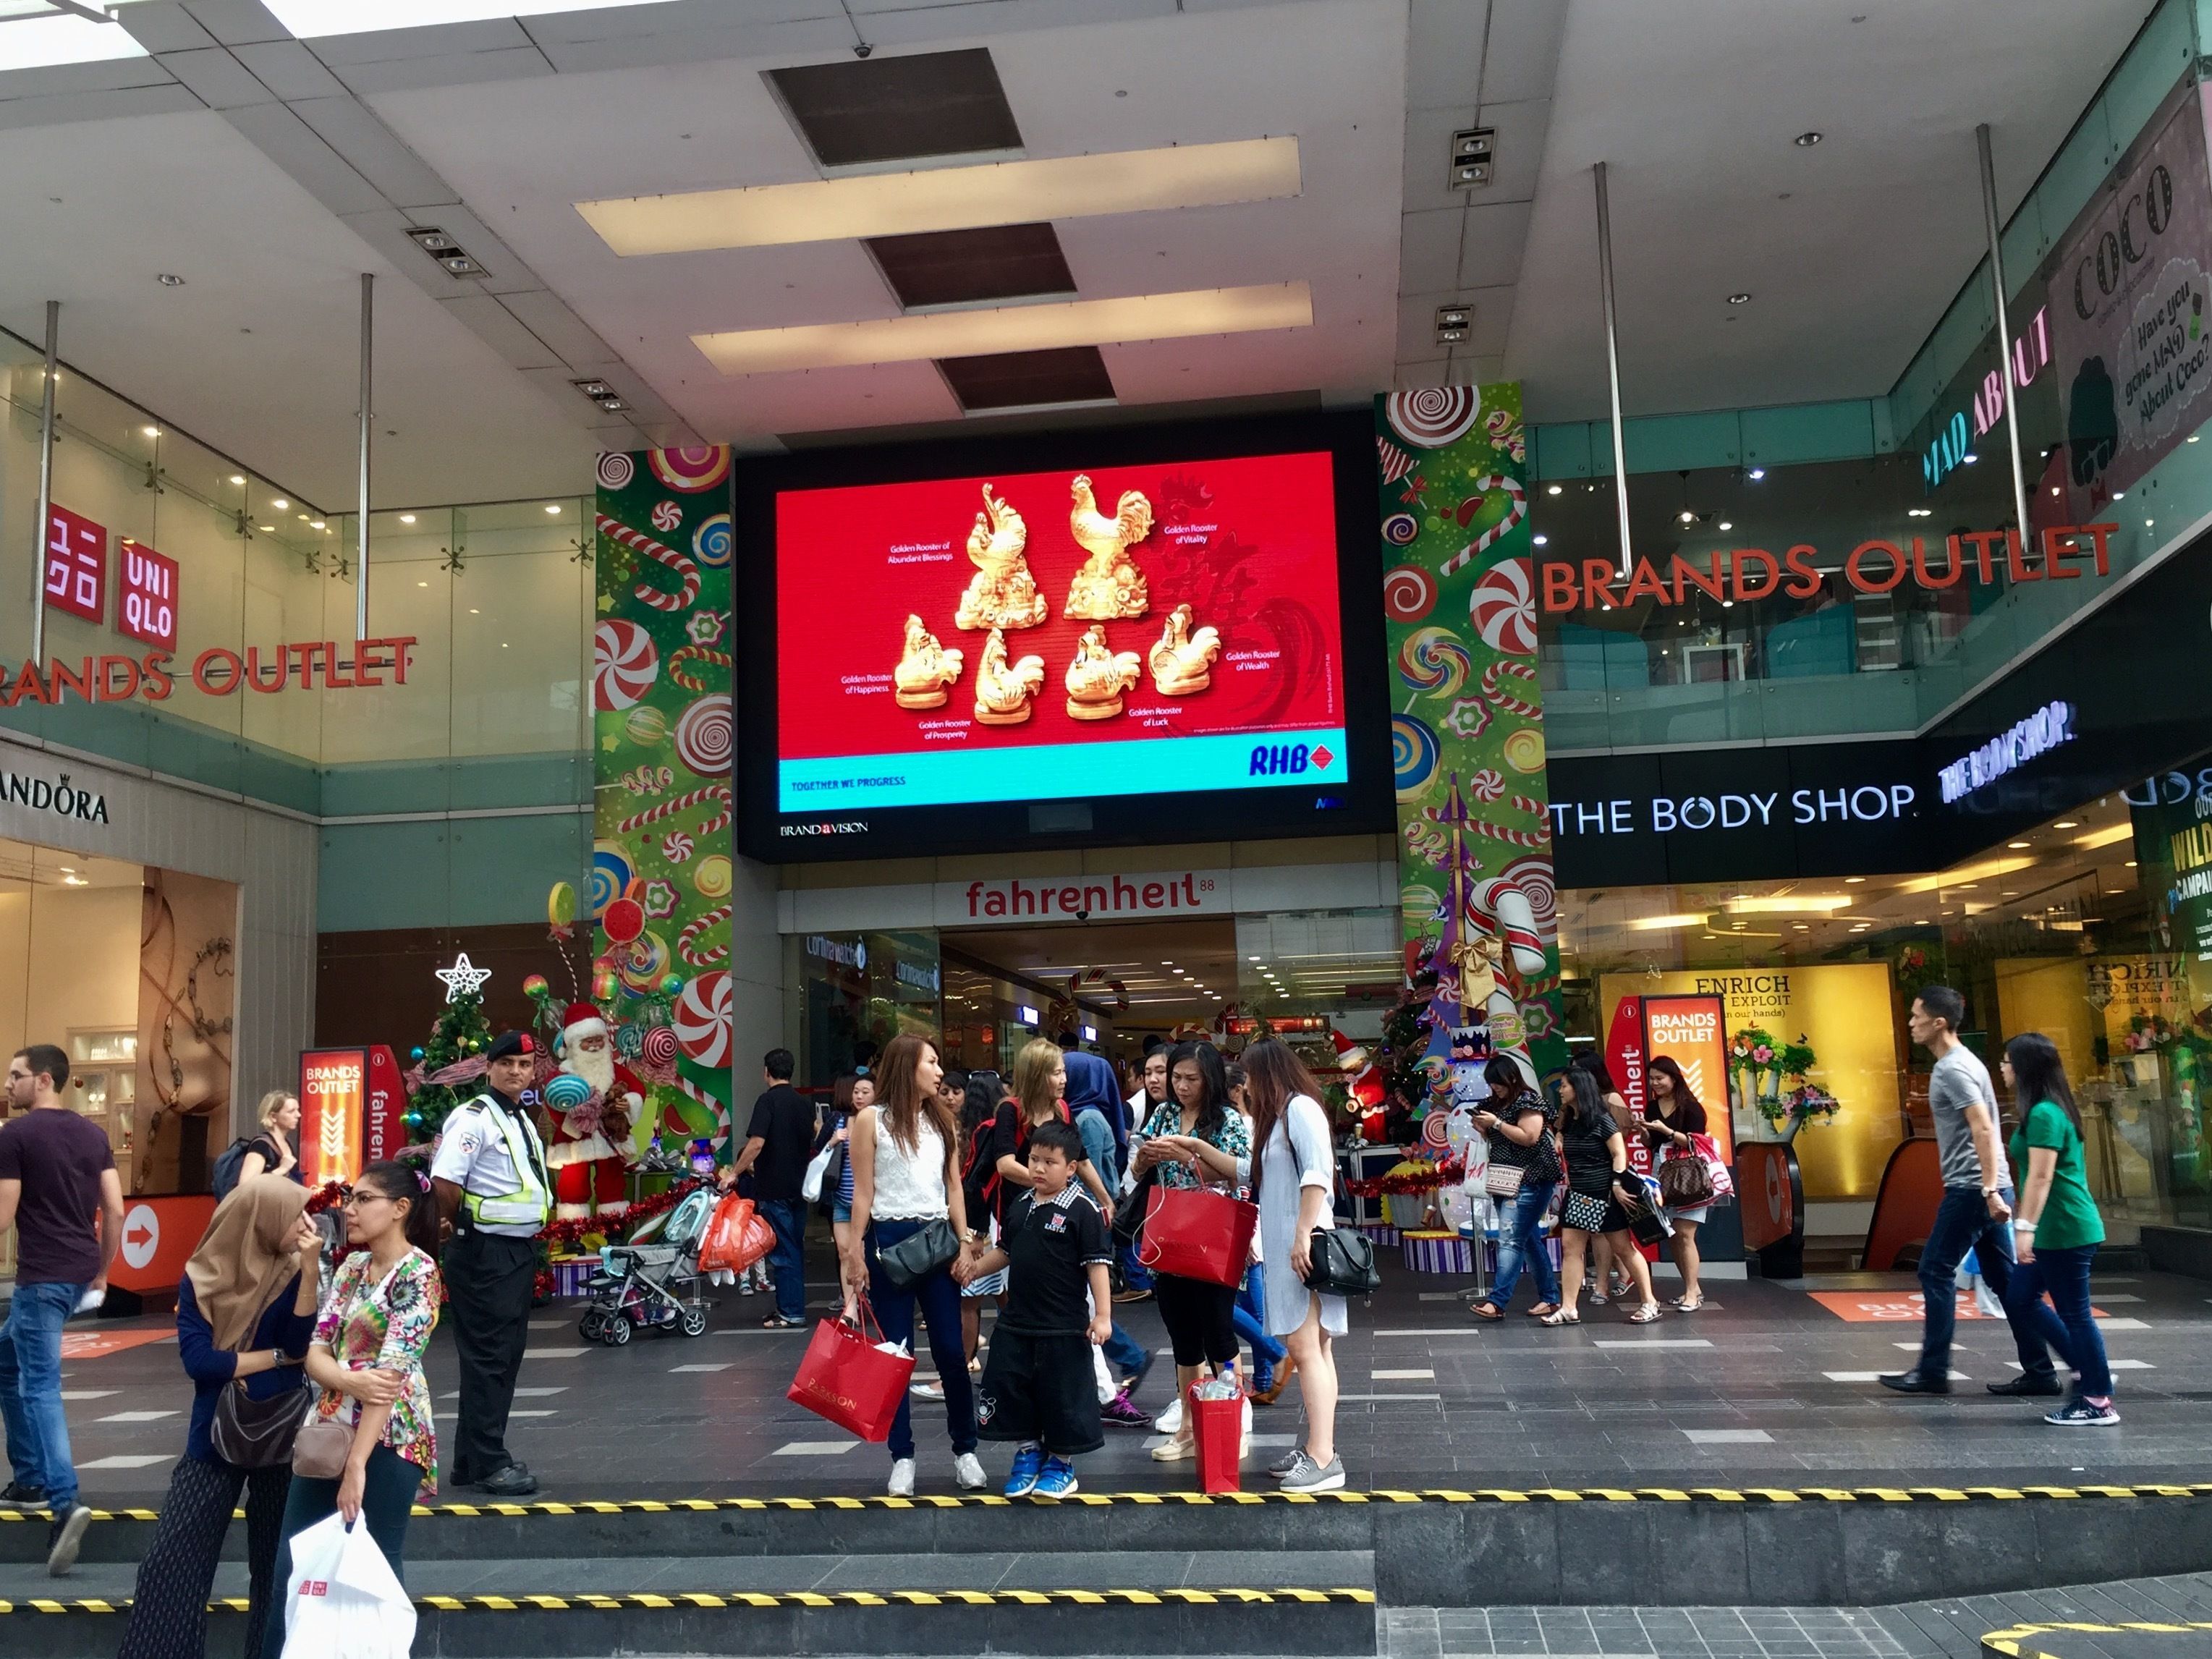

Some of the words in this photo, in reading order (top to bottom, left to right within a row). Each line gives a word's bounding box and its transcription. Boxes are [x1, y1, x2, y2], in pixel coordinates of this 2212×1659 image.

[2075, 165, 2172, 320] COCO
[2137, 308, 2165, 351] Have
[2167, 281, 2190, 326] you
[2140, 371, 2174, 423] About
[2176, 333, 2209, 391] Coco?
[1923, 412, 1967, 496] MAD
[1164, 526, 1190, 535] Golden
[890, 544, 915, 553] Golden
[916, 543, 941, 552] Rooster
[1183, 535, 1208, 544] Vitality
[888, 554, 921, 564] Abundant
[923, 553, 953, 562] Blessings
[128, 551, 169, 600] UNI
[1541, 543, 1823, 614] BRANDS
[1845, 522, 2119, 595] OUTLET
[126, 593, 171, 637] QLO
[1225, 652, 1252, 661] Golden
[1253, 650, 1281, 659] Rooster
[0, 653, 174, 707] ANDS
[192, 636, 418, 696] OUTLET
[1244, 661, 1269, 670] Wealth
[854, 684, 889, 695] Happiness
[933, 731, 967, 741] Prosperity
[1250, 743, 1309, 776] RHB
[792, 780, 839, 792] TOGETHER
[841, 779, 855, 789] WE
[857, 776, 906, 787] PROGRESS
[1938, 758, 1973, 804] THE
[1548, 799, 1634, 836] THE
[1653, 792, 1778, 833] BODY
[966, 873, 1201, 917] fahrenheit
[1200, 878, 1215, 892] 88
[1695, 975, 1791, 995] ENRICH
[1651, 1012, 1716, 1029] BRANDS
[1753, 1009, 1786, 1019] hands)
[1653, 1028, 1714, 1044] OUTLET
[306, 1066, 361, 1081] BRANDS
[307, 1080, 360, 1095] OUTLET
